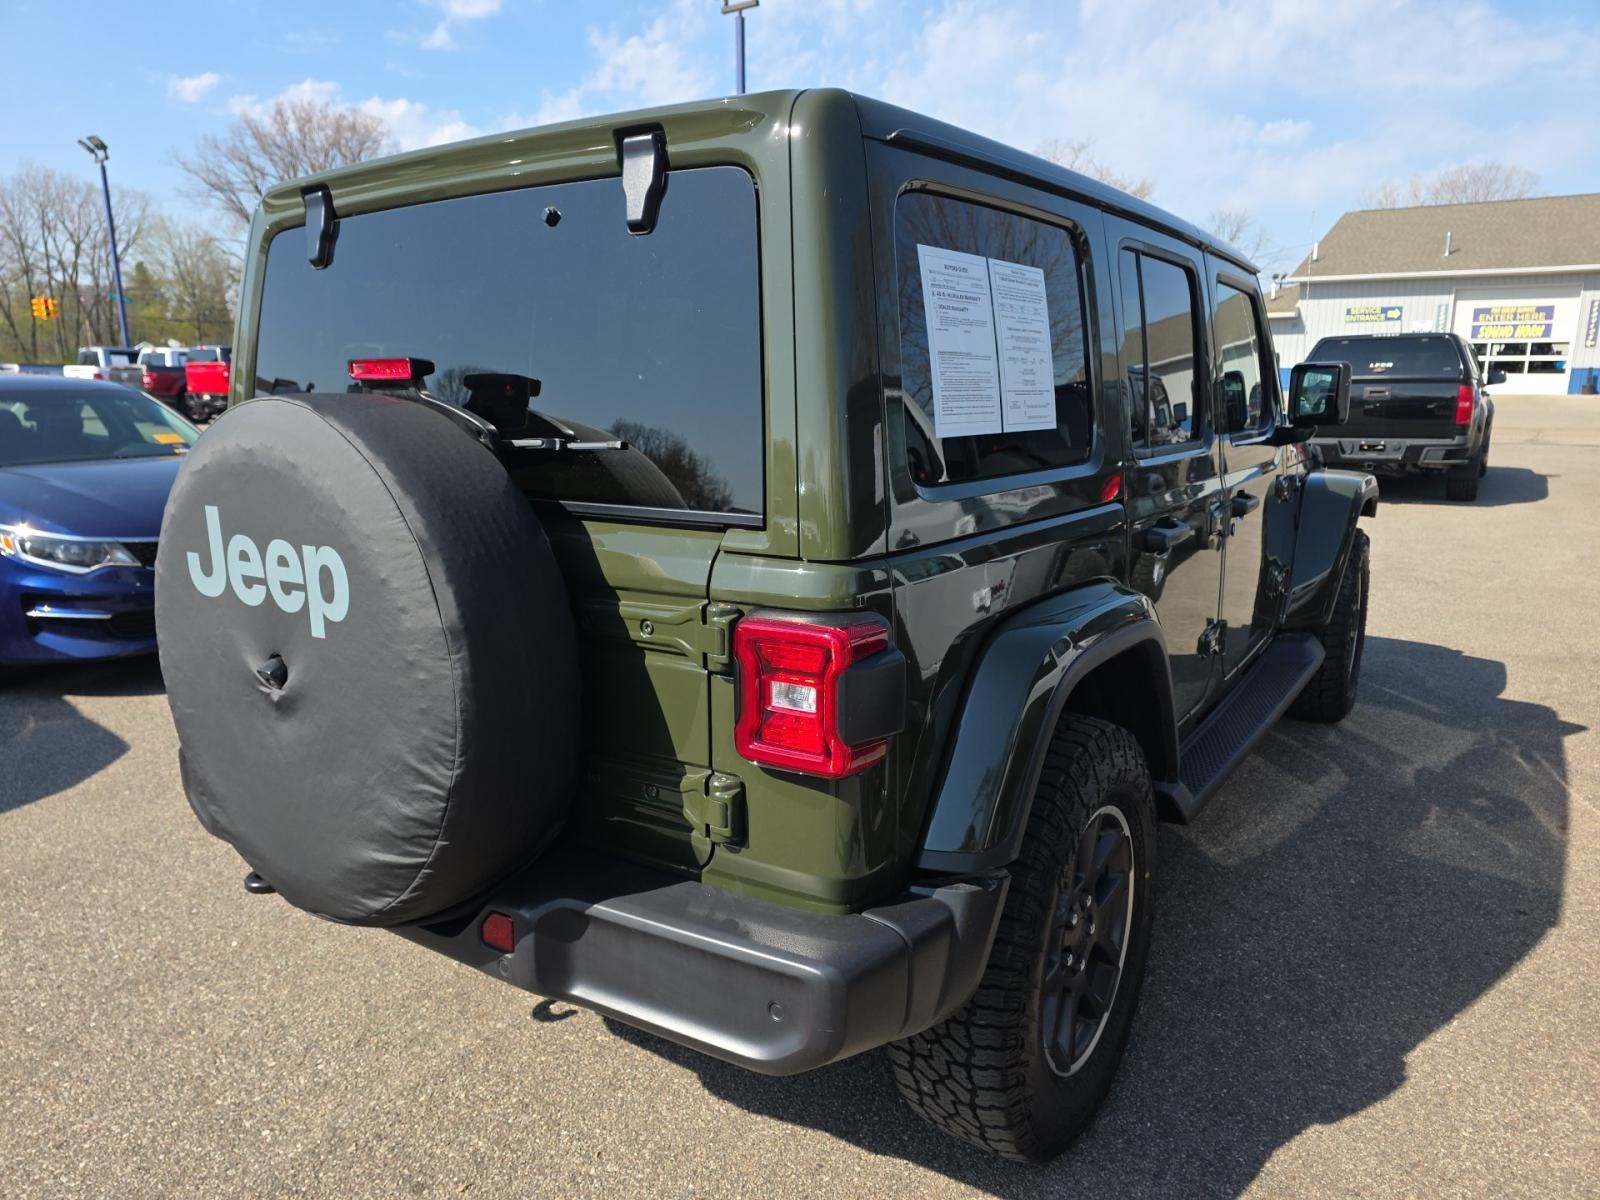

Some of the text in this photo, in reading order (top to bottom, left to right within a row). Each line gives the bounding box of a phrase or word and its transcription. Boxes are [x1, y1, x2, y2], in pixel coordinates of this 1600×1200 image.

[1345, 313, 1385, 323] ENTRANCE
[1478, 311, 1546, 322] ENTER HERE
[1477, 325, 1546, 339] SOUND HORN
[186, 505, 350, 639] Jeep
